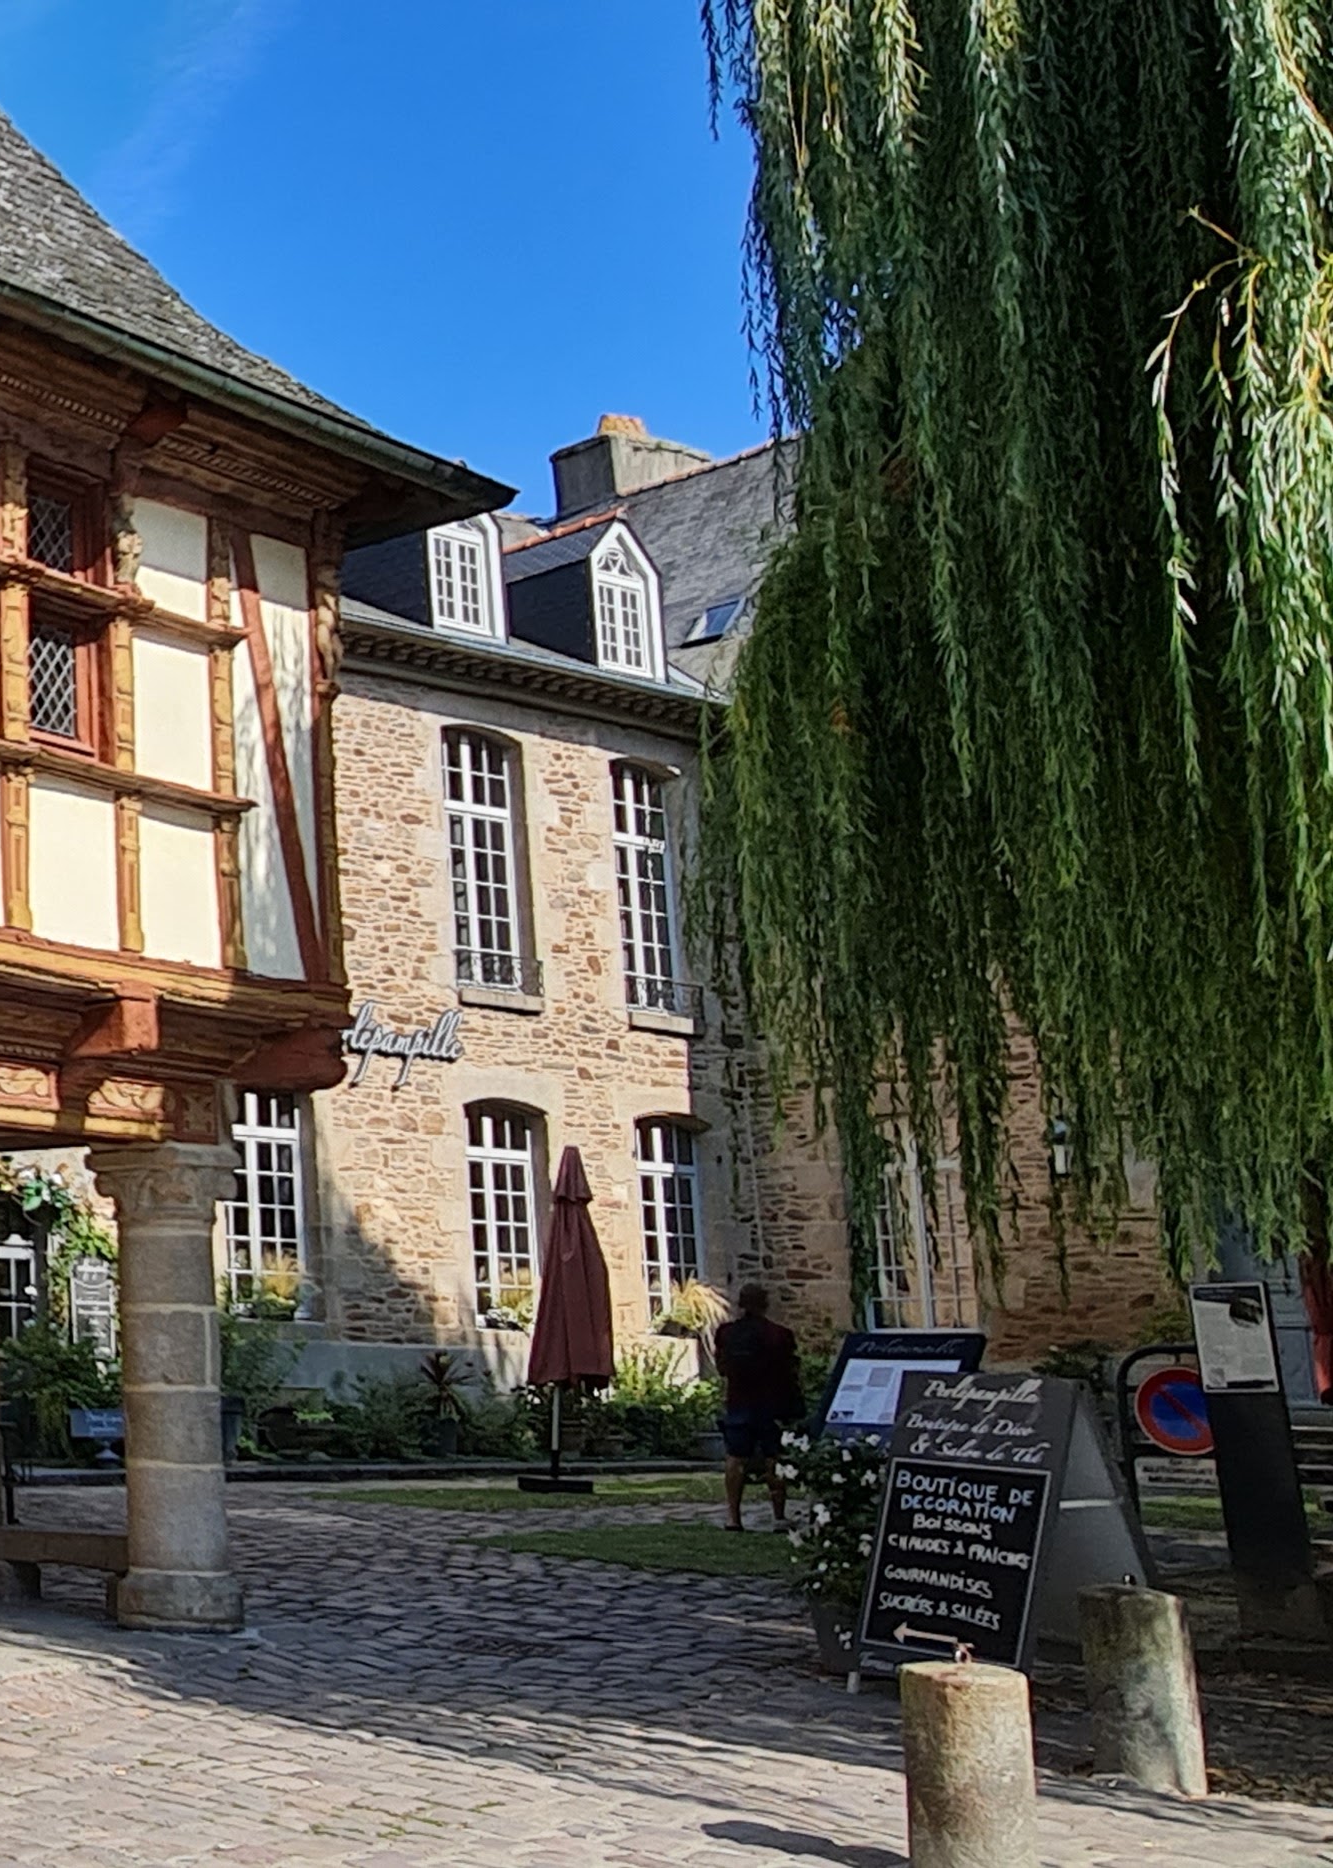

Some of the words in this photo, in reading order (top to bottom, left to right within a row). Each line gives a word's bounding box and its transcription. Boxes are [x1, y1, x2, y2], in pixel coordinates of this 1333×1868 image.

[909, 1433, 931, 1455] &
[1008, 1488, 1035, 1506] DE
[936, 1601, 948, 1616] &
